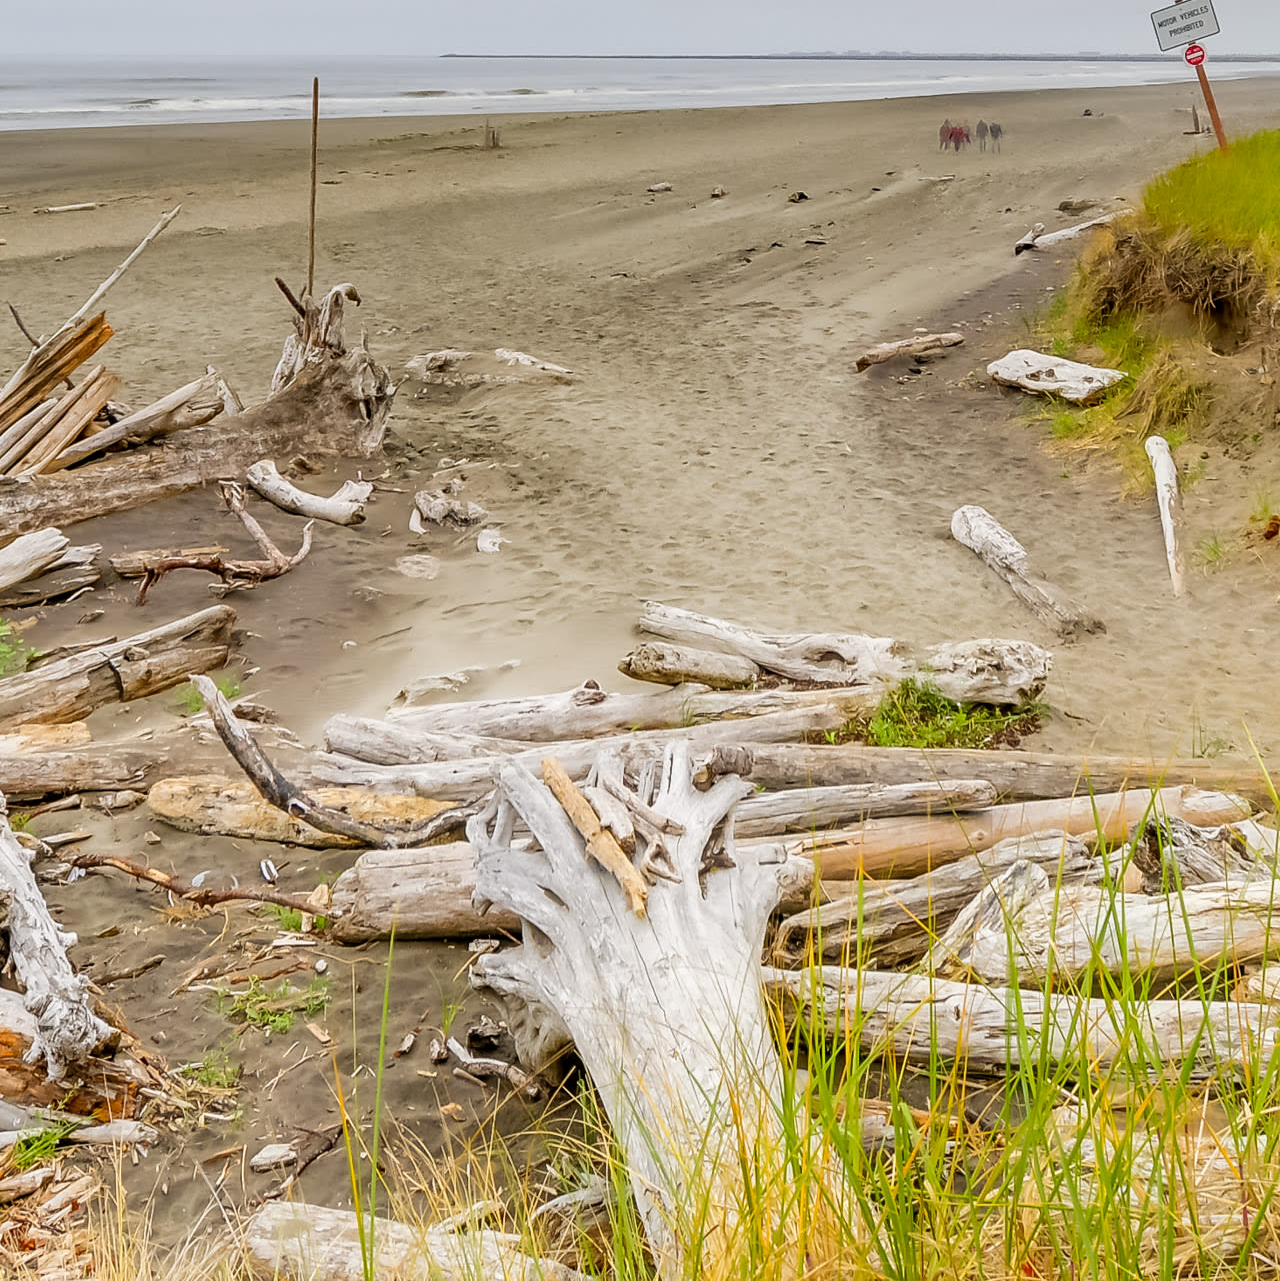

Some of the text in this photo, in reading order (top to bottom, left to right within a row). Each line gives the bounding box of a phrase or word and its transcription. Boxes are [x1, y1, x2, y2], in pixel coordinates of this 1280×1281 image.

[1157, 5, 1209, 29] MOTOR VEHICLES
[1169, 20, 1204, 38] PROHIBITED
